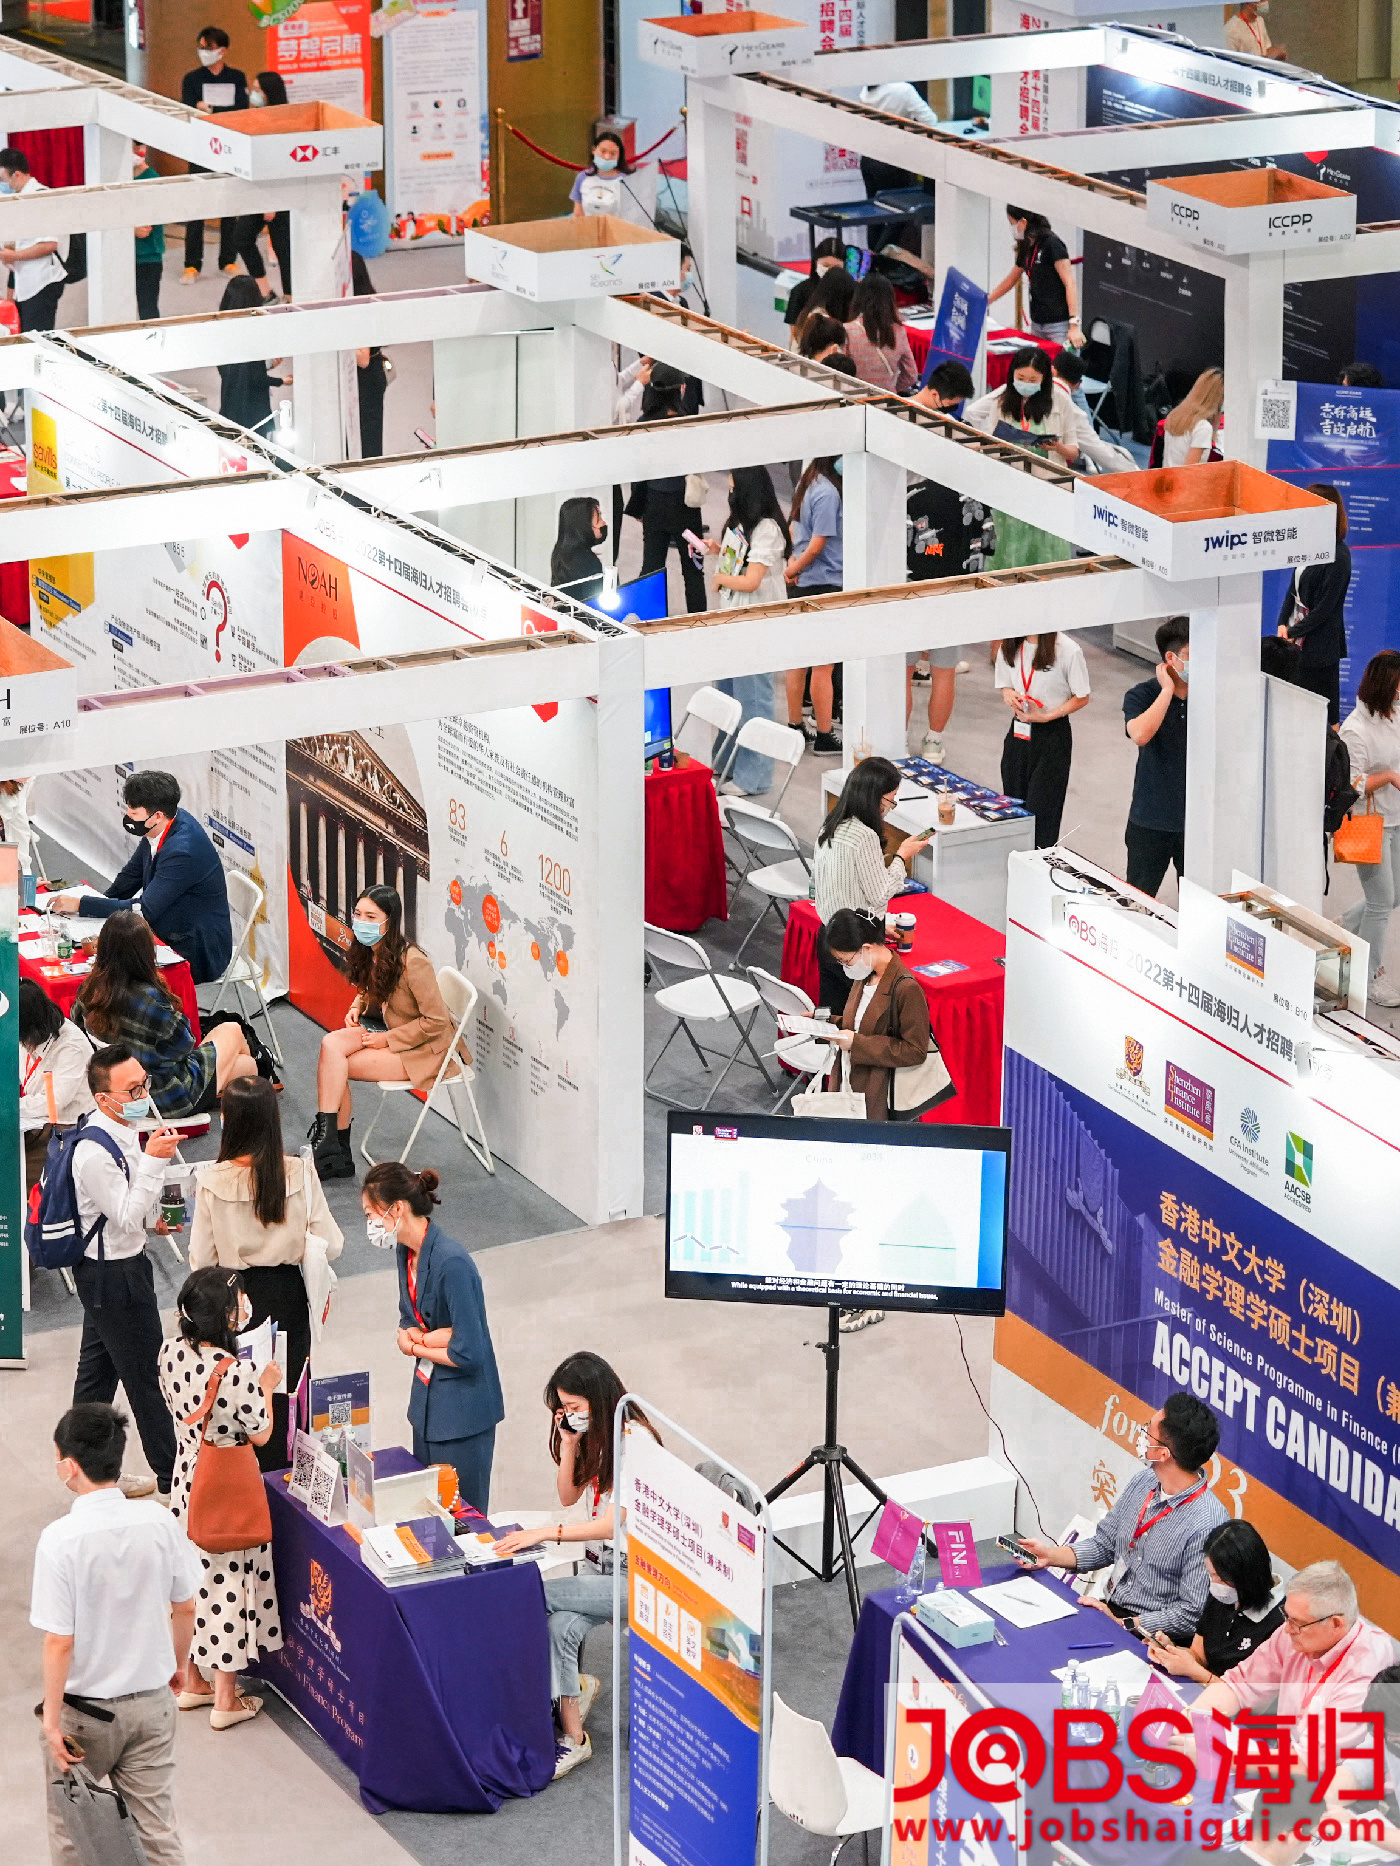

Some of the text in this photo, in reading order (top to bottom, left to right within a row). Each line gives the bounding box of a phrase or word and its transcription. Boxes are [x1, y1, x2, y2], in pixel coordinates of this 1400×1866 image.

[1171, 202, 1200, 221] ICCPP
[1268, 213, 1313, 229] ICCPP
[33, 443, 58, 471] savills
[1120, 517, 1149, 543] 智微智能
[1251, 527, 1298, 545] 智微智能
[297, 555, 338, 602] NOAH
[449, 798, 466, 831] 83
[500, 830, 508, 857] 6
[538, 853, 571, 897] 1200
[1167, 1079, 1196, 1105] Finance
[1169, 1065, 1201, 1097] Shenzhen
[1168, 1090, 1200, 1120] Institute
[1230, 1136, 1269, 1167] CFA Institute
[1284, 1180, 1311, 1205] AACSB
[1159, 1190, 1362, 1346] 香港中文大学（深圳）
[731, 1281, 748, 1289] While
[748, 1283, 777, 1291] equipped
[796, 1286, 827, 1294] theoretical
[1152, 1320, 1261, 1433] ACCEPT
[1154, 1287, 1388, 1456] Master of Science Programme in Finance
[1097, 1393, 1141, 1450] for
[947, 1529, 969, 1566] FIN
[302, 1673, 331, 1714] Finance
[331, 1704, 365, 1749] Program
